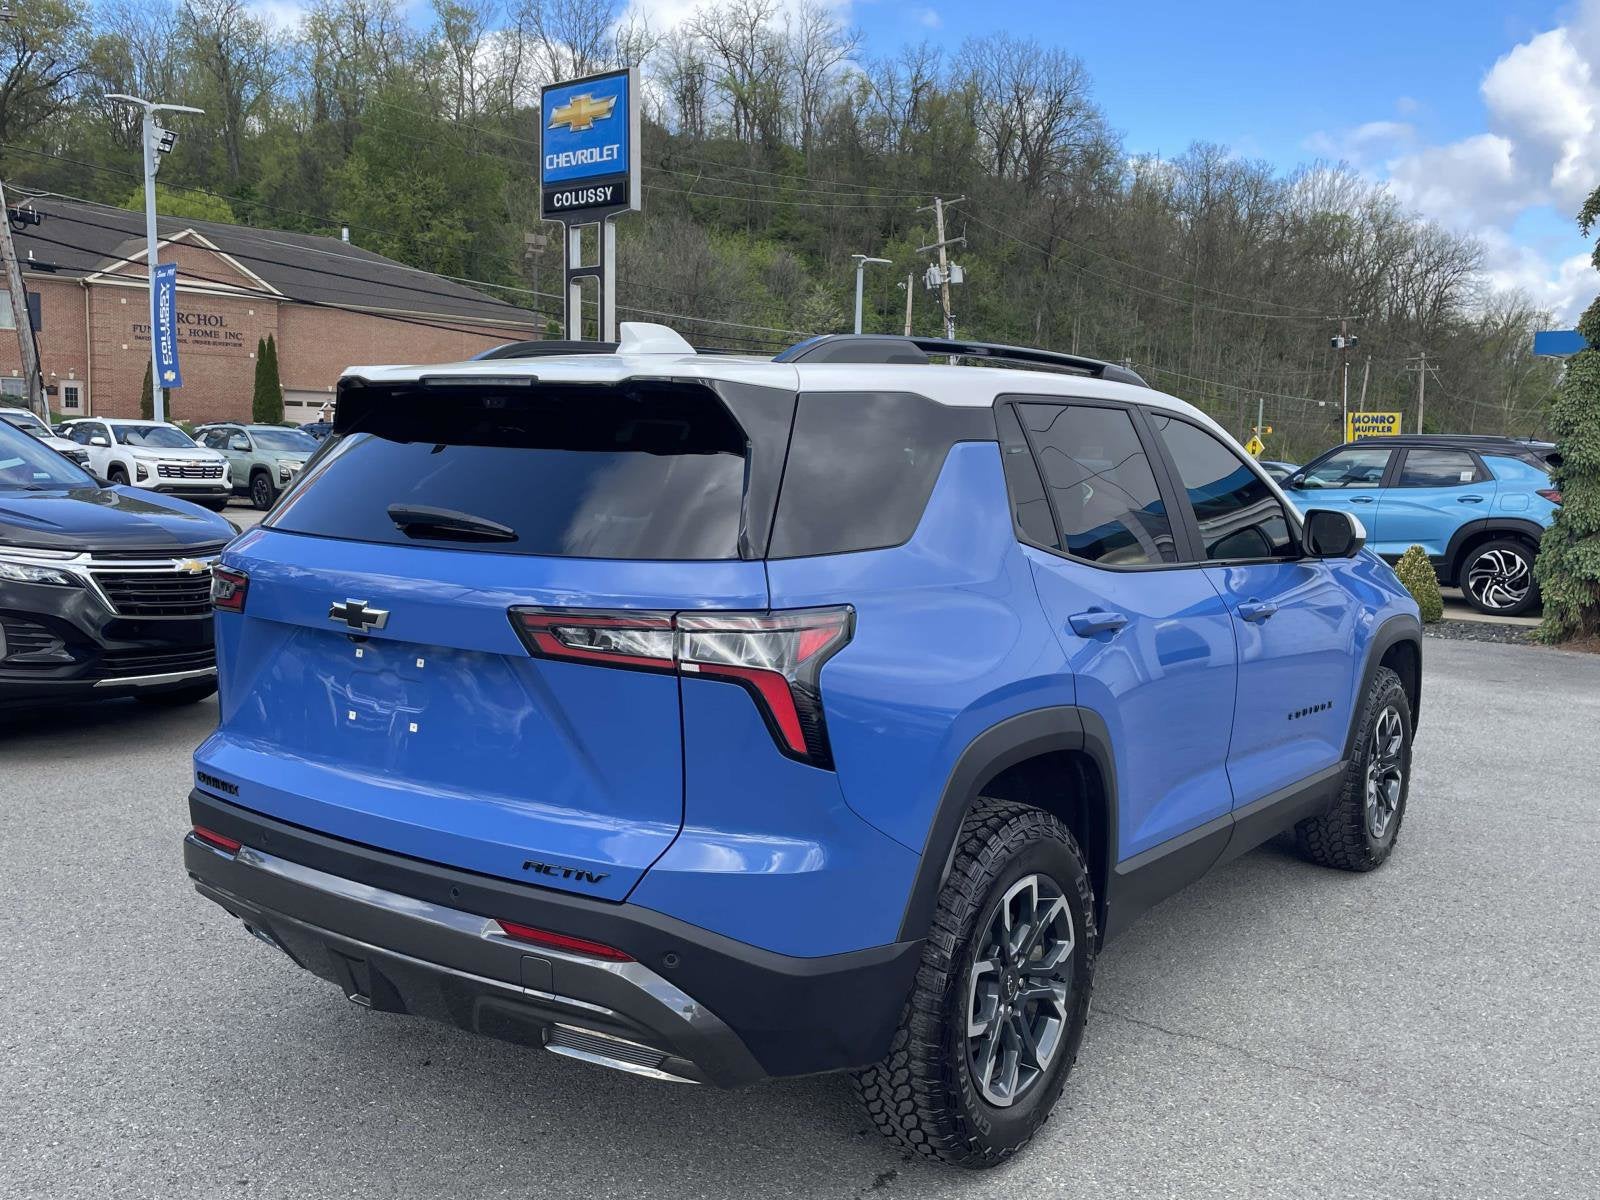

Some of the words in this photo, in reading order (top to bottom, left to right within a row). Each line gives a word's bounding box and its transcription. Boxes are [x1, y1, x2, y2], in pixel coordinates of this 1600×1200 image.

[545, 143, 619, 170] CHEVROLET
[553, 186, 613, 207] COLUSSY
[160, 283, 169, 365] COLUSSY
[165, 284, 173, 364] CHEVROLET
[176, 312, 228, 328] RCHOL
[189, 328, 221, 339] HOME
[1351, 415, 1395, 424] MONRO
[1354, 425, 1392, 433] MUFFLER
[522, 859, 611, 884] ACTIV
